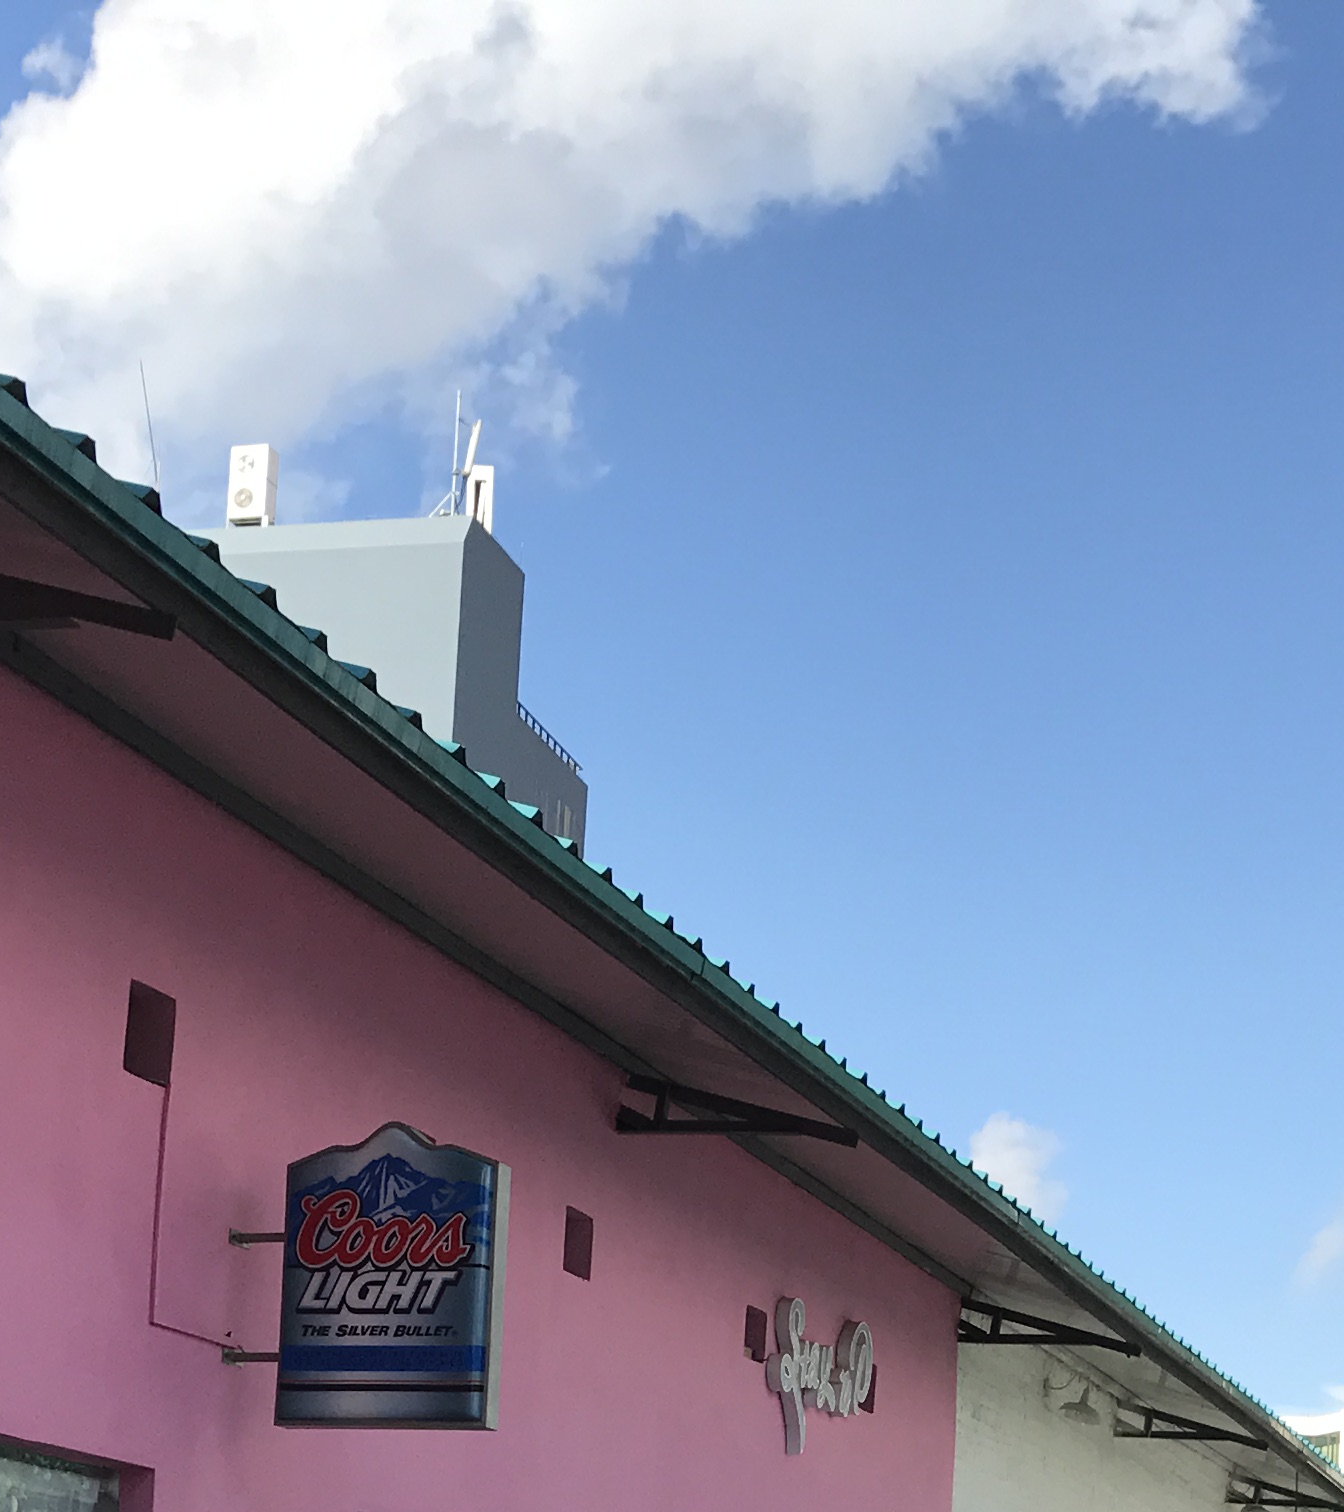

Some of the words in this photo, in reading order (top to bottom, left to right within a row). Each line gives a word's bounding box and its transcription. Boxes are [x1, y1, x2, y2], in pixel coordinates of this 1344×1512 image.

[296, 1189, 474, 1269] Coors
[296, 1269, 459, 1314] LIGHT
[301, 1324, 332, 1338] THE
[335, 1324, 390, 1338] SILVER
[393, 1324, 454, 1338] BULLET
